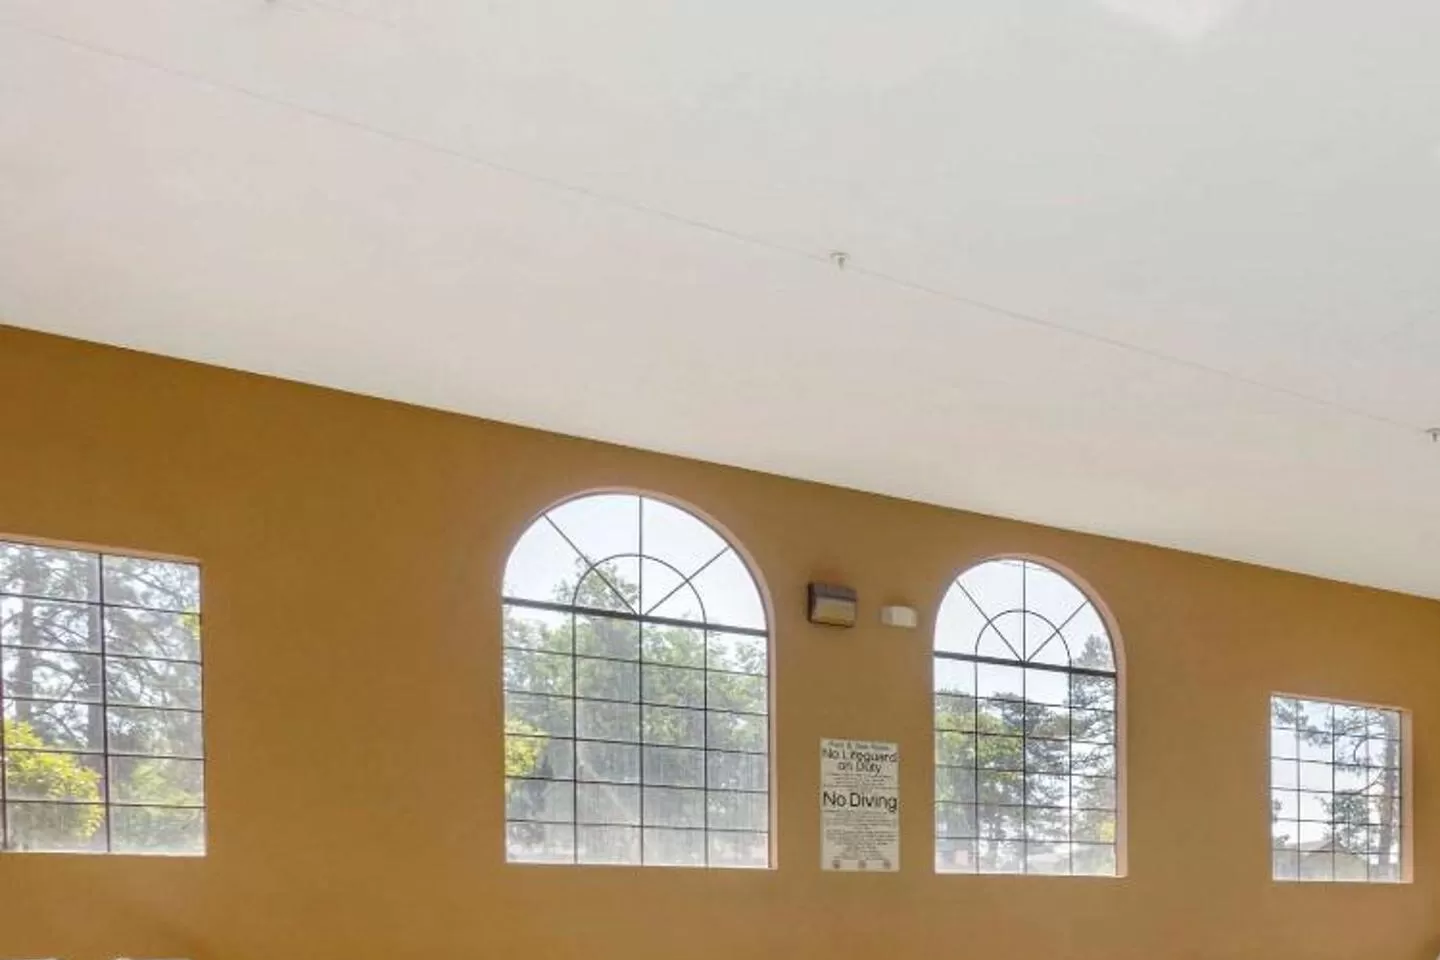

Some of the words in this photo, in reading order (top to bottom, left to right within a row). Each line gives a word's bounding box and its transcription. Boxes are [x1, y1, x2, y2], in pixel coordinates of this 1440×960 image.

[822, 747, 839, 758] No
[823, 791, 847, 807] No
[850, 792, 898, 813] Diving
